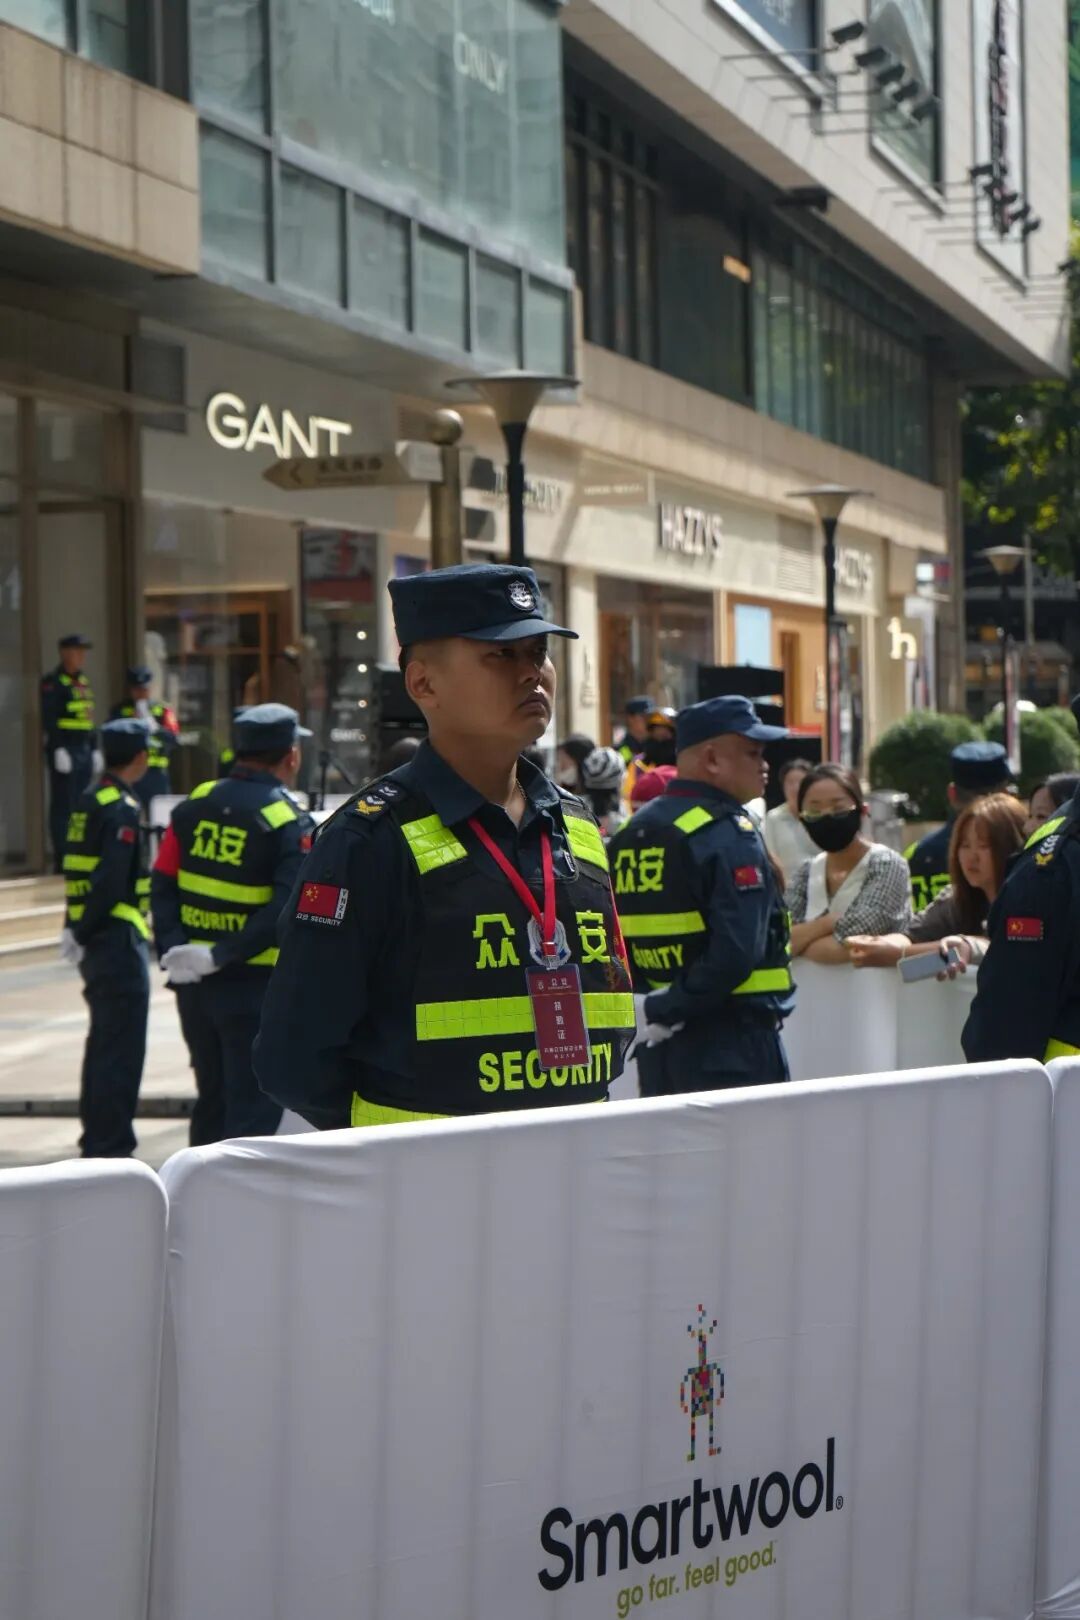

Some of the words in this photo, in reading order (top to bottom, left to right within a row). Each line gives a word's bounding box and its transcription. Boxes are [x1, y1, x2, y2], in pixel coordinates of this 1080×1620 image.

[206, 392, 352, 459] GANT
[659, 503, 723, 559] HAZZYS
[190, 819, 248, 866] 众安
[614, 847, 665, 893] 众安
[310, 915, 342, 927] SECURITY
[632, 943, 683, 969] URITY
[617, 1585, 644, 1619] go
[648, 1573, 680, 1601] far.
[685, 1556, 720, 1591] feel
[725, 1540, 777, 1587] good.
